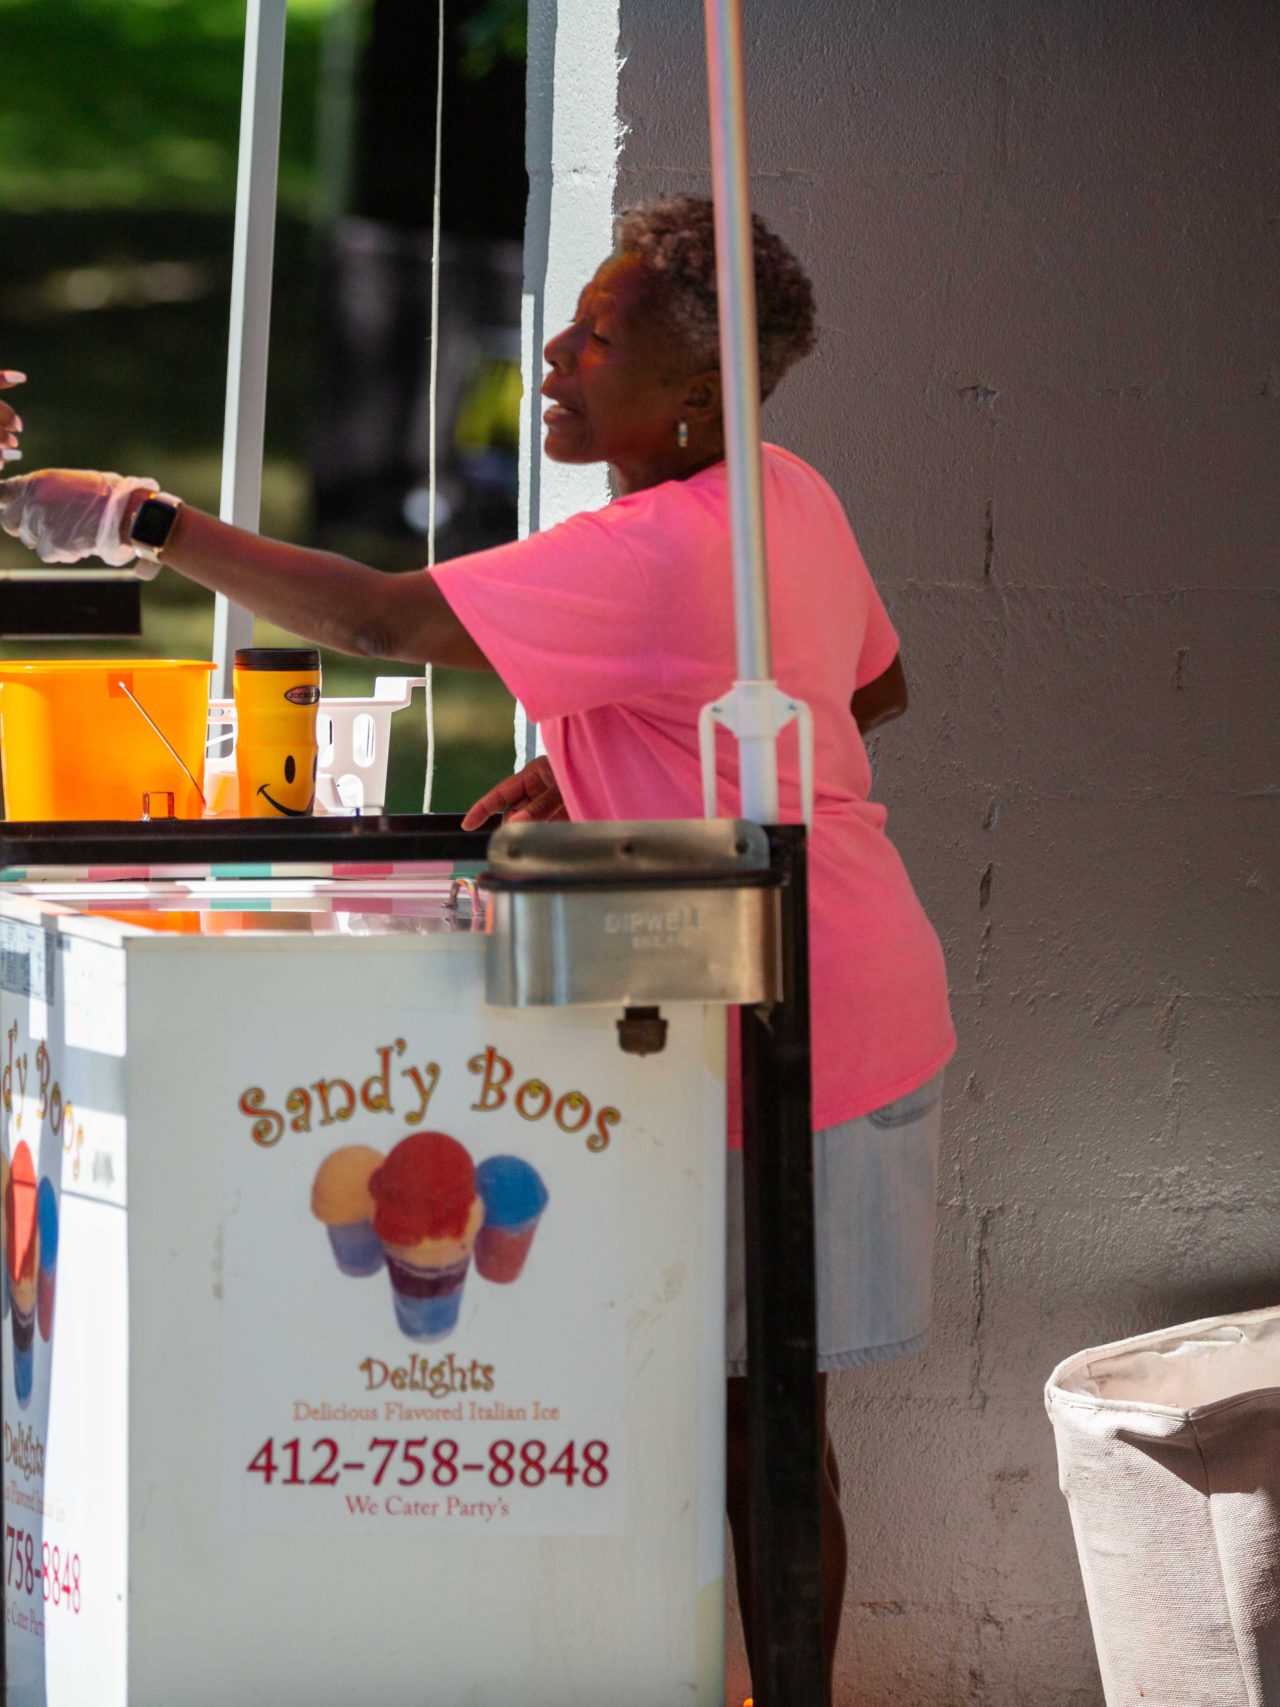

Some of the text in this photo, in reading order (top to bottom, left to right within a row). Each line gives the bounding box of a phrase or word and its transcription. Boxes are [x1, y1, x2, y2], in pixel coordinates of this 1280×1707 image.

[239, 1036, 621, 1153] Sand'y Boos
[359, 1353, 495, 1398] Delights
[293, 1401, 559, 1421] Delicious Flavored Italian Ice
[247, 1437, 609, 1487] 412-758-8848
[345, 1496, 509, 1522] We Cater Party's
